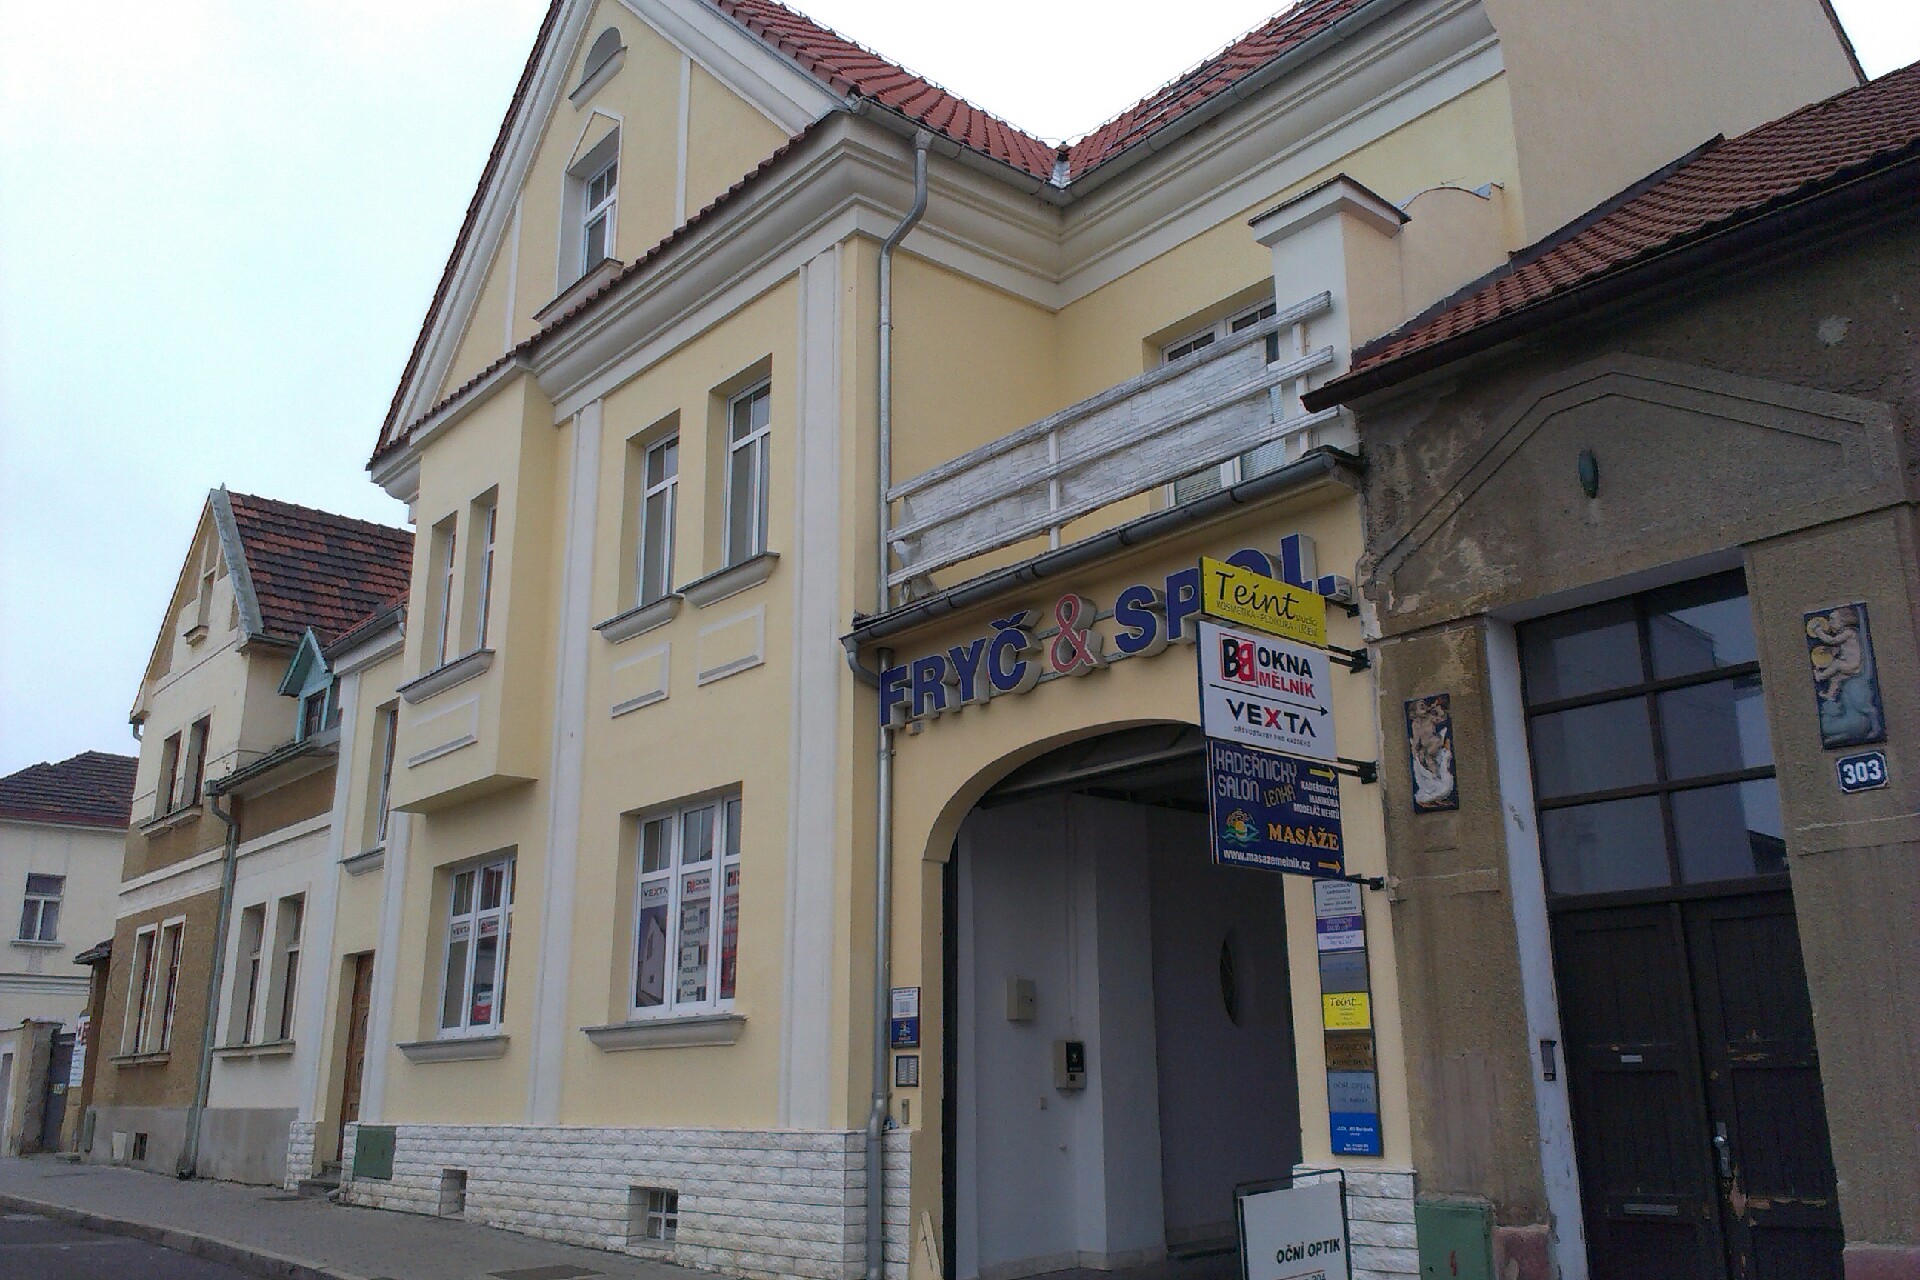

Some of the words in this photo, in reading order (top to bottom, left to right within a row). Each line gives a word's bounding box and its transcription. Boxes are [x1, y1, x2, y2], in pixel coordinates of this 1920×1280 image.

[1215, 570, 1299, 620] Teint
[879, 609, 1031, 728] FRYČ
[1049, 593, 1098, 675] &
[1257, 646, 1313, 679] OKNA
[1258, 669, 1316, 699] MĚLNÍK
[1225, 698, 1317, 738] VEXTA
[1843, 759, 1882, 785] 303
[1267, 823, 1340, 851] MASÁŽE
[1223, 849, 1311, 871] www.masazemelnik.cz
[1276, 1241, 1305, 1265] OČNÍ
[1307, 1238, 1341, 1258] OPTIK
